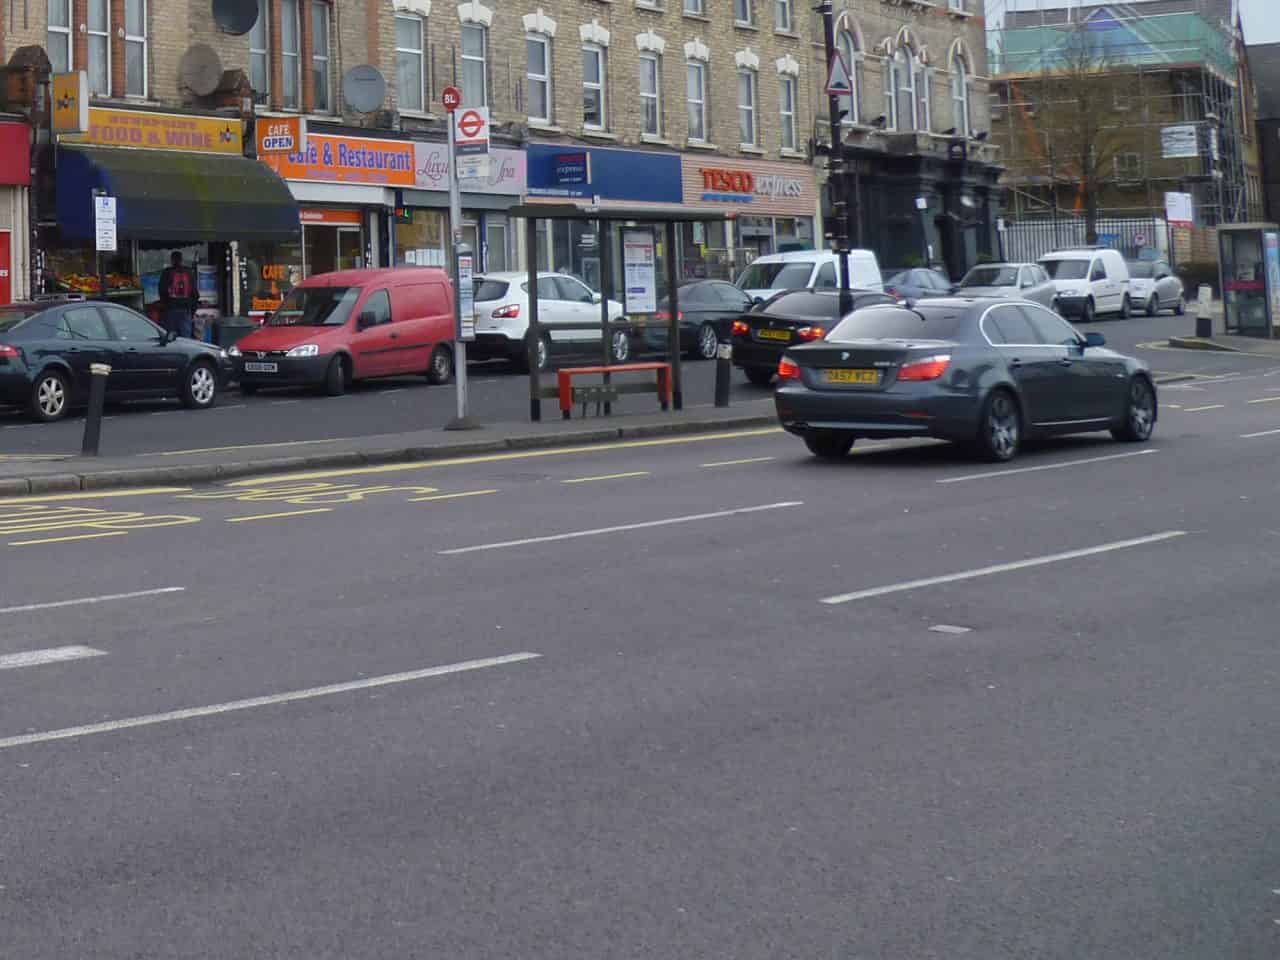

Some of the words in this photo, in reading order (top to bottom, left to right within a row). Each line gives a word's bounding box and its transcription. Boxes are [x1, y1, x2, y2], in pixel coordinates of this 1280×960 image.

[90, 125, 143, 144] FOOD
[166, 130, 213, 148] WINE
[264, 137, 292, 148] OPEN
[323, 142, 333, 166] &
[338, 144, 411, 170] Restaurant
[700, 167, 753, 192] TESCO
